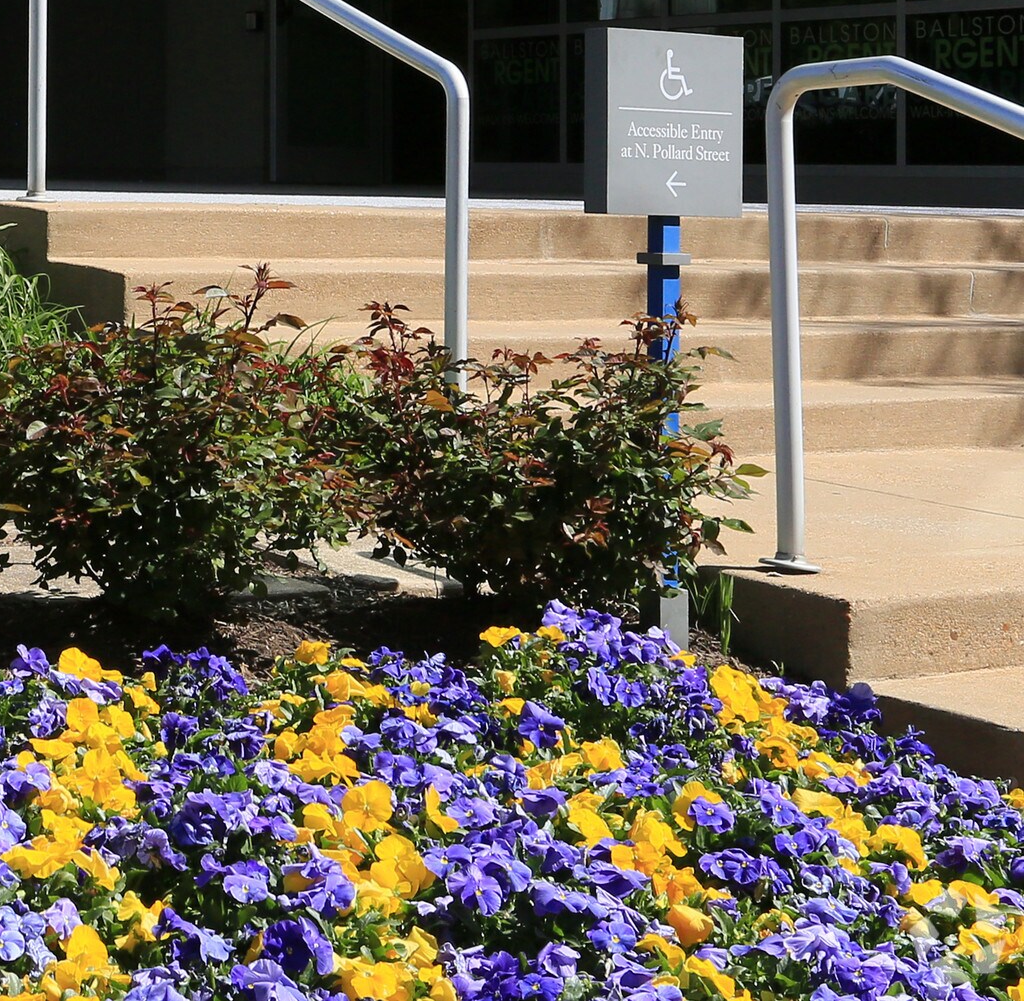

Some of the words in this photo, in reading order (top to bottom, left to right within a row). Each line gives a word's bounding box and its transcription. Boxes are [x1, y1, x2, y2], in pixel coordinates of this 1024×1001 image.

[790, 22, 896, 45] BALLSTON
[628, 121, 688, 139] Accessible
[691, 124, 724, 144] Entry
[620, 146, 633, 158] at
[635, 143, 650, 159] N.
[653, 143, 693, 160] Pollard
[696, 145, 730, 162] Street
